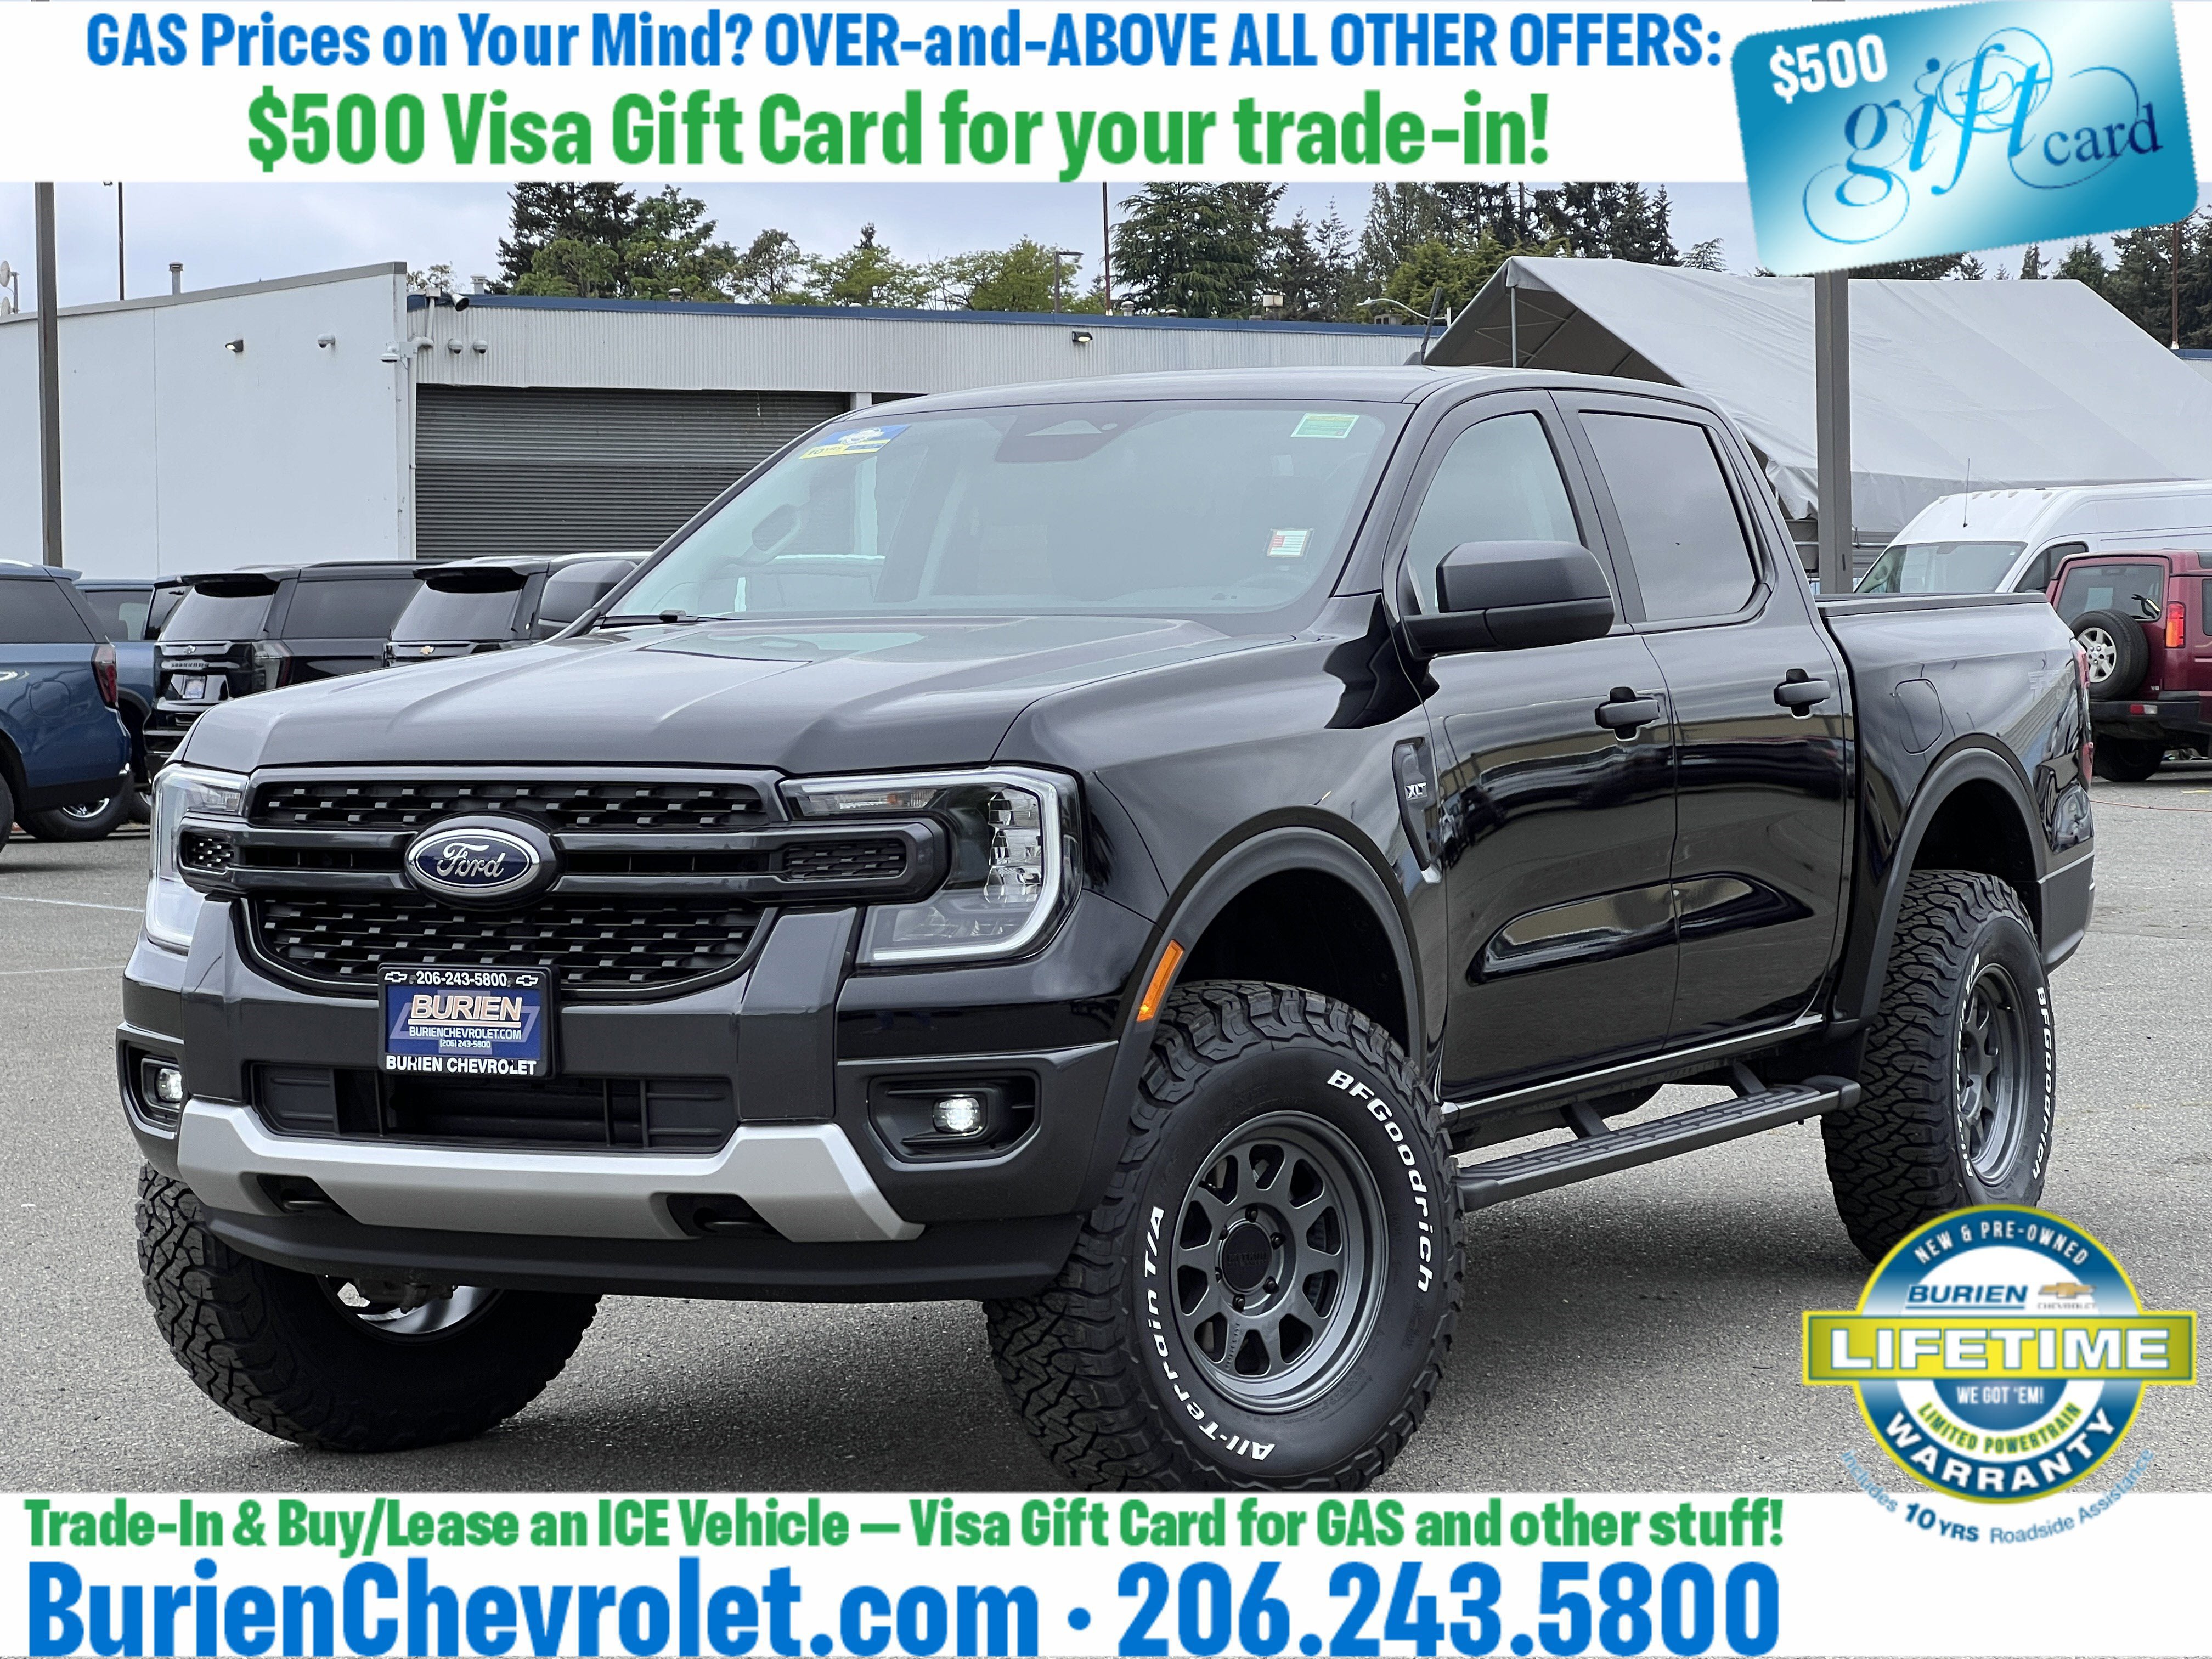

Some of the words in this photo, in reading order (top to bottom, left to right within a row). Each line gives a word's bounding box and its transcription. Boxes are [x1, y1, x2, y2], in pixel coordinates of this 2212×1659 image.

[1406, 782, 1426, 798] XLT
[437, 842, 505, 877] Ford
[416, 971, 507, 987] 206-243-5800
[410, 995, 522, 1021] BURIEN
[409, 1026, 521, 1040] BURIENCHEVROLET.COM
[458, 1040, 491, 1048] 243-5800
[386, 1056, 443, 1072] BURIEN
[447, 1058, 537, 1075] CHEVROLET
[1327, 1070, 1434, 1293] BFGoodrich
[1144, 1206, 1164, 1279] T/A
[1147, 1288, 1276, 1462] All-Terrain
